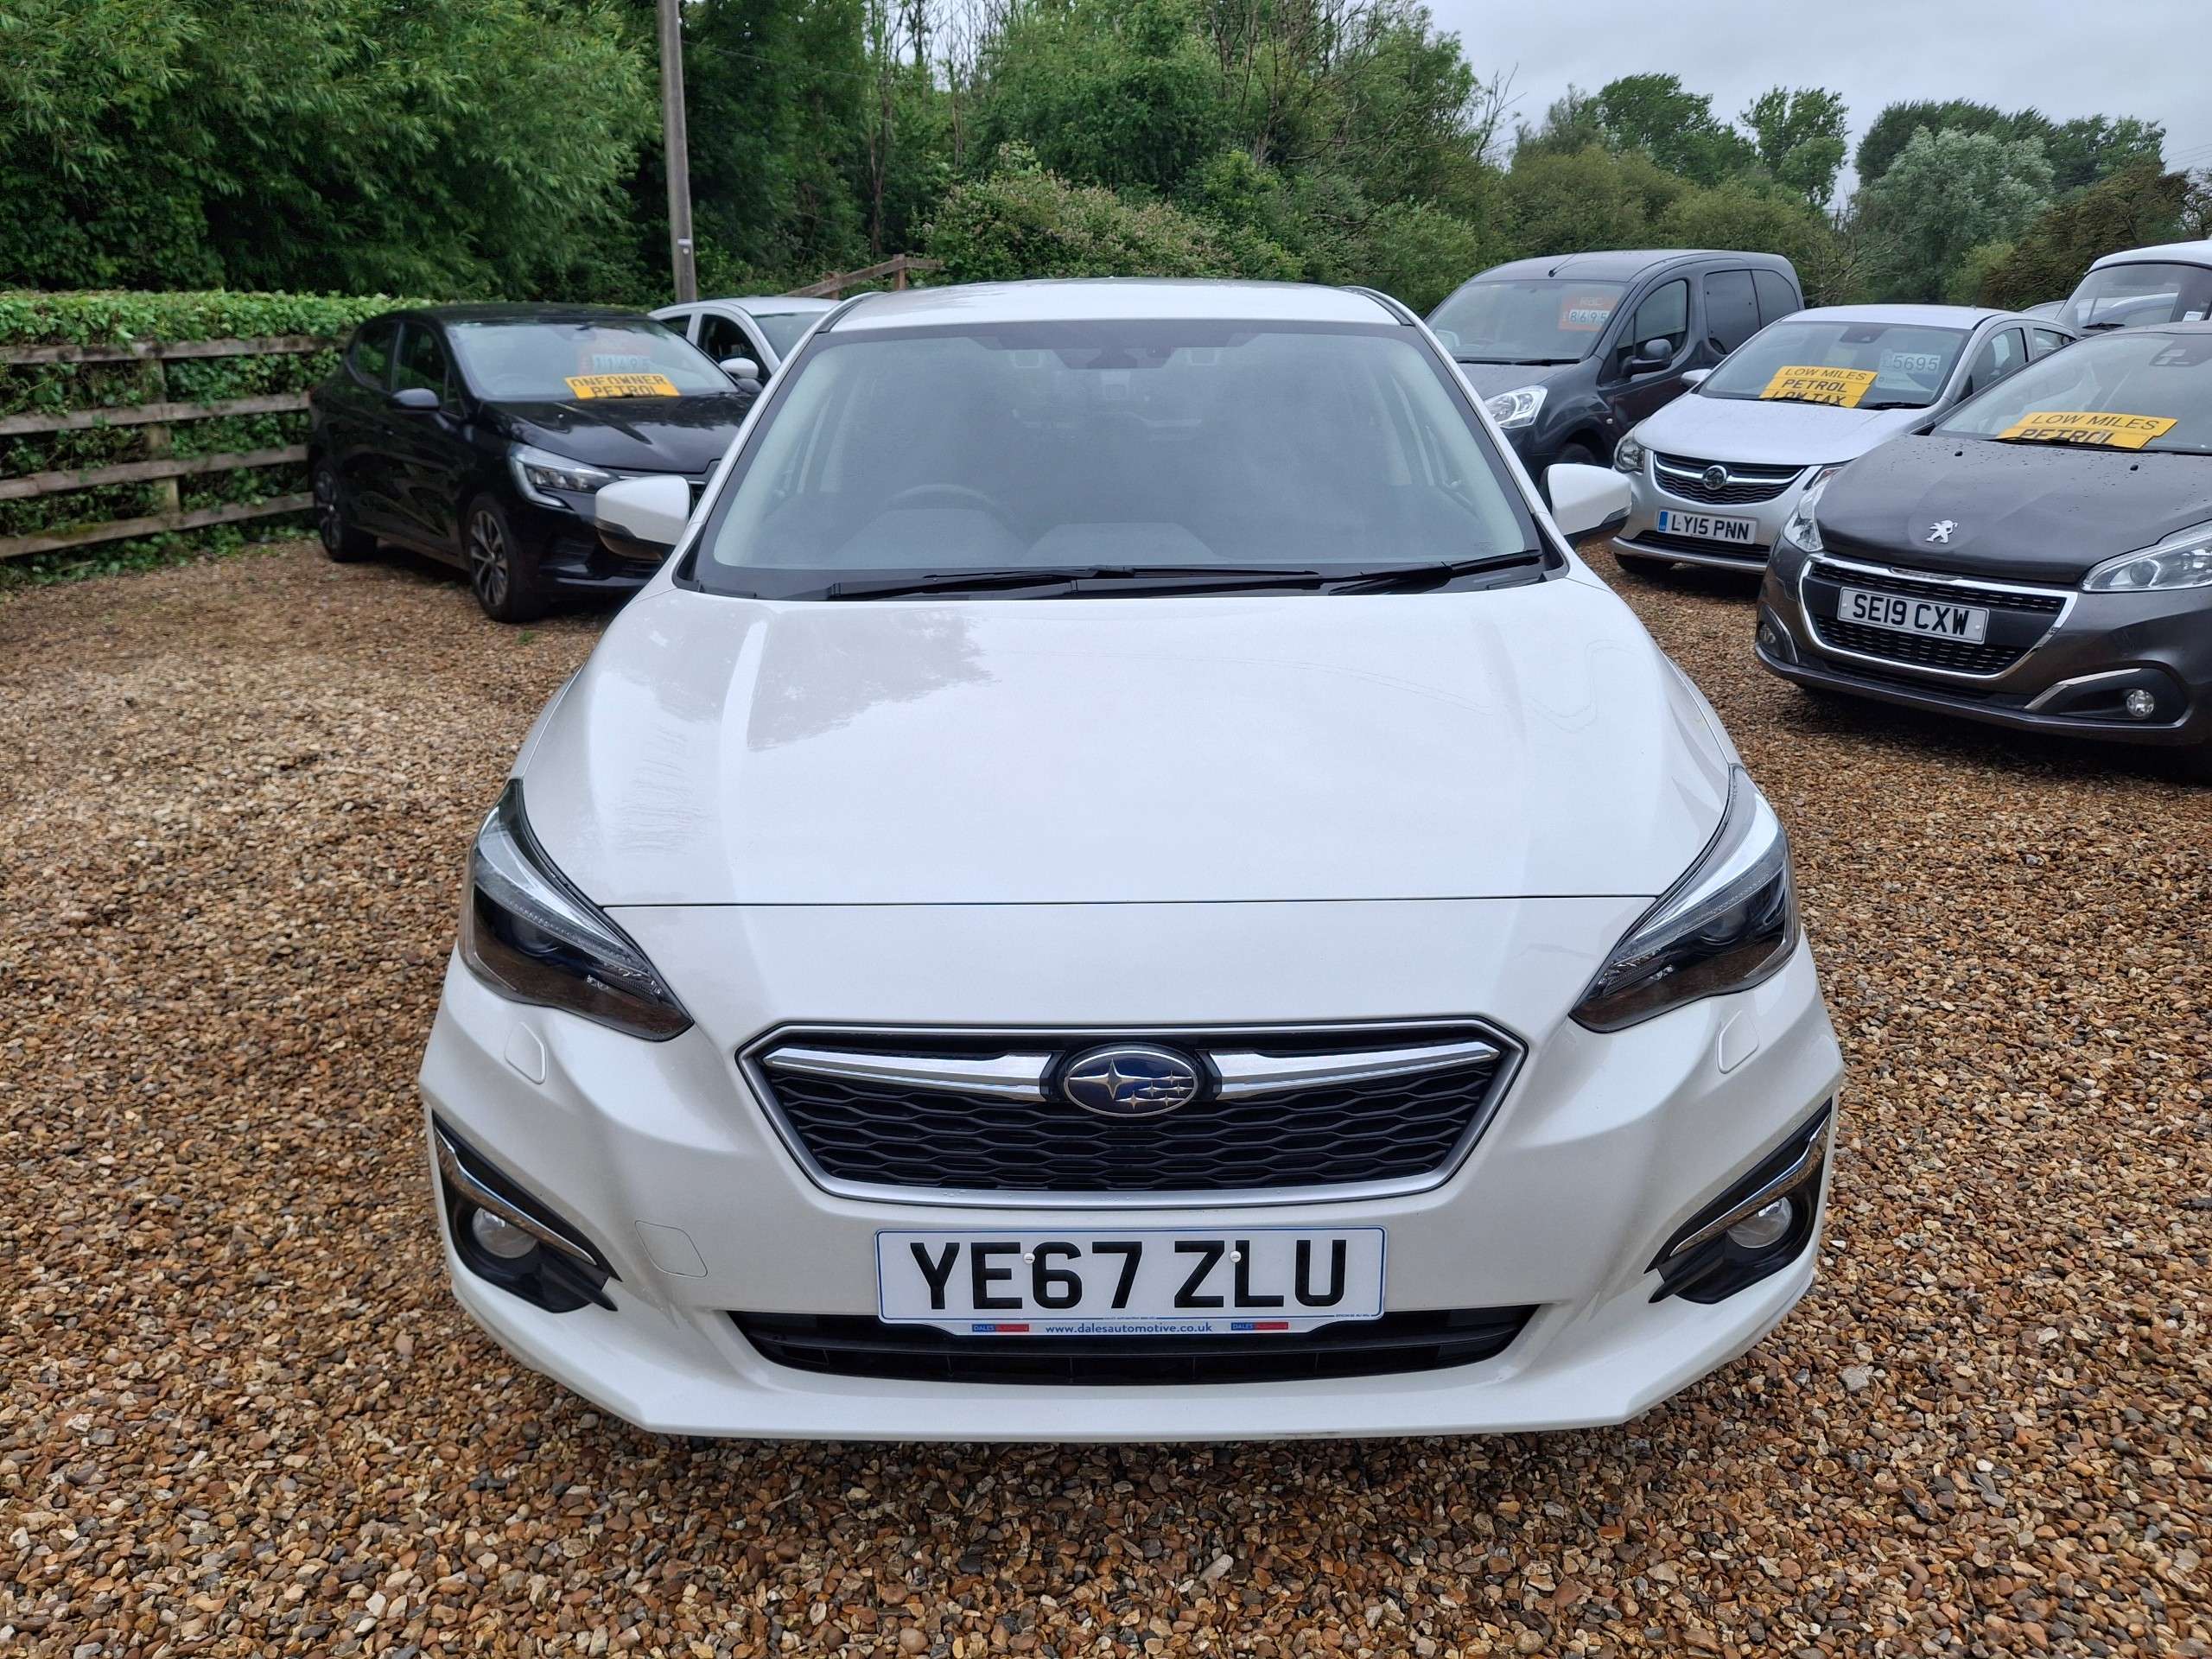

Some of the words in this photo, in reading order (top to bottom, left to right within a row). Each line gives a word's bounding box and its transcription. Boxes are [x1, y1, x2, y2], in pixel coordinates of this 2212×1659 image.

[1570, 311, 1608, 324] 8695
[1893, 355, 1939, 372] 5695
[1784, 367, 1819, 376] LOW
[1821, 369, 1866, 381] MILES
[1781, 378, 1847, 393] PETROL
[1812, 393, 1847, 406] TAX
[2031, 414, 2085, 425] LOW
[2086, 415, 2159, 430] MILES
[1671, 514, 1710, 535] LY15
[1713, 519, 1750, 540] PNN
[1853, 594, 1908, 626] SE19
[1914, 603, 1970, 636] CXW
[910, 1241, 1143, 1310] YE67
[1173, 1239, 1347, 1309] ZLU
[1045, 1322, 1213, 1334] www.dalesautomotive.co.uk
